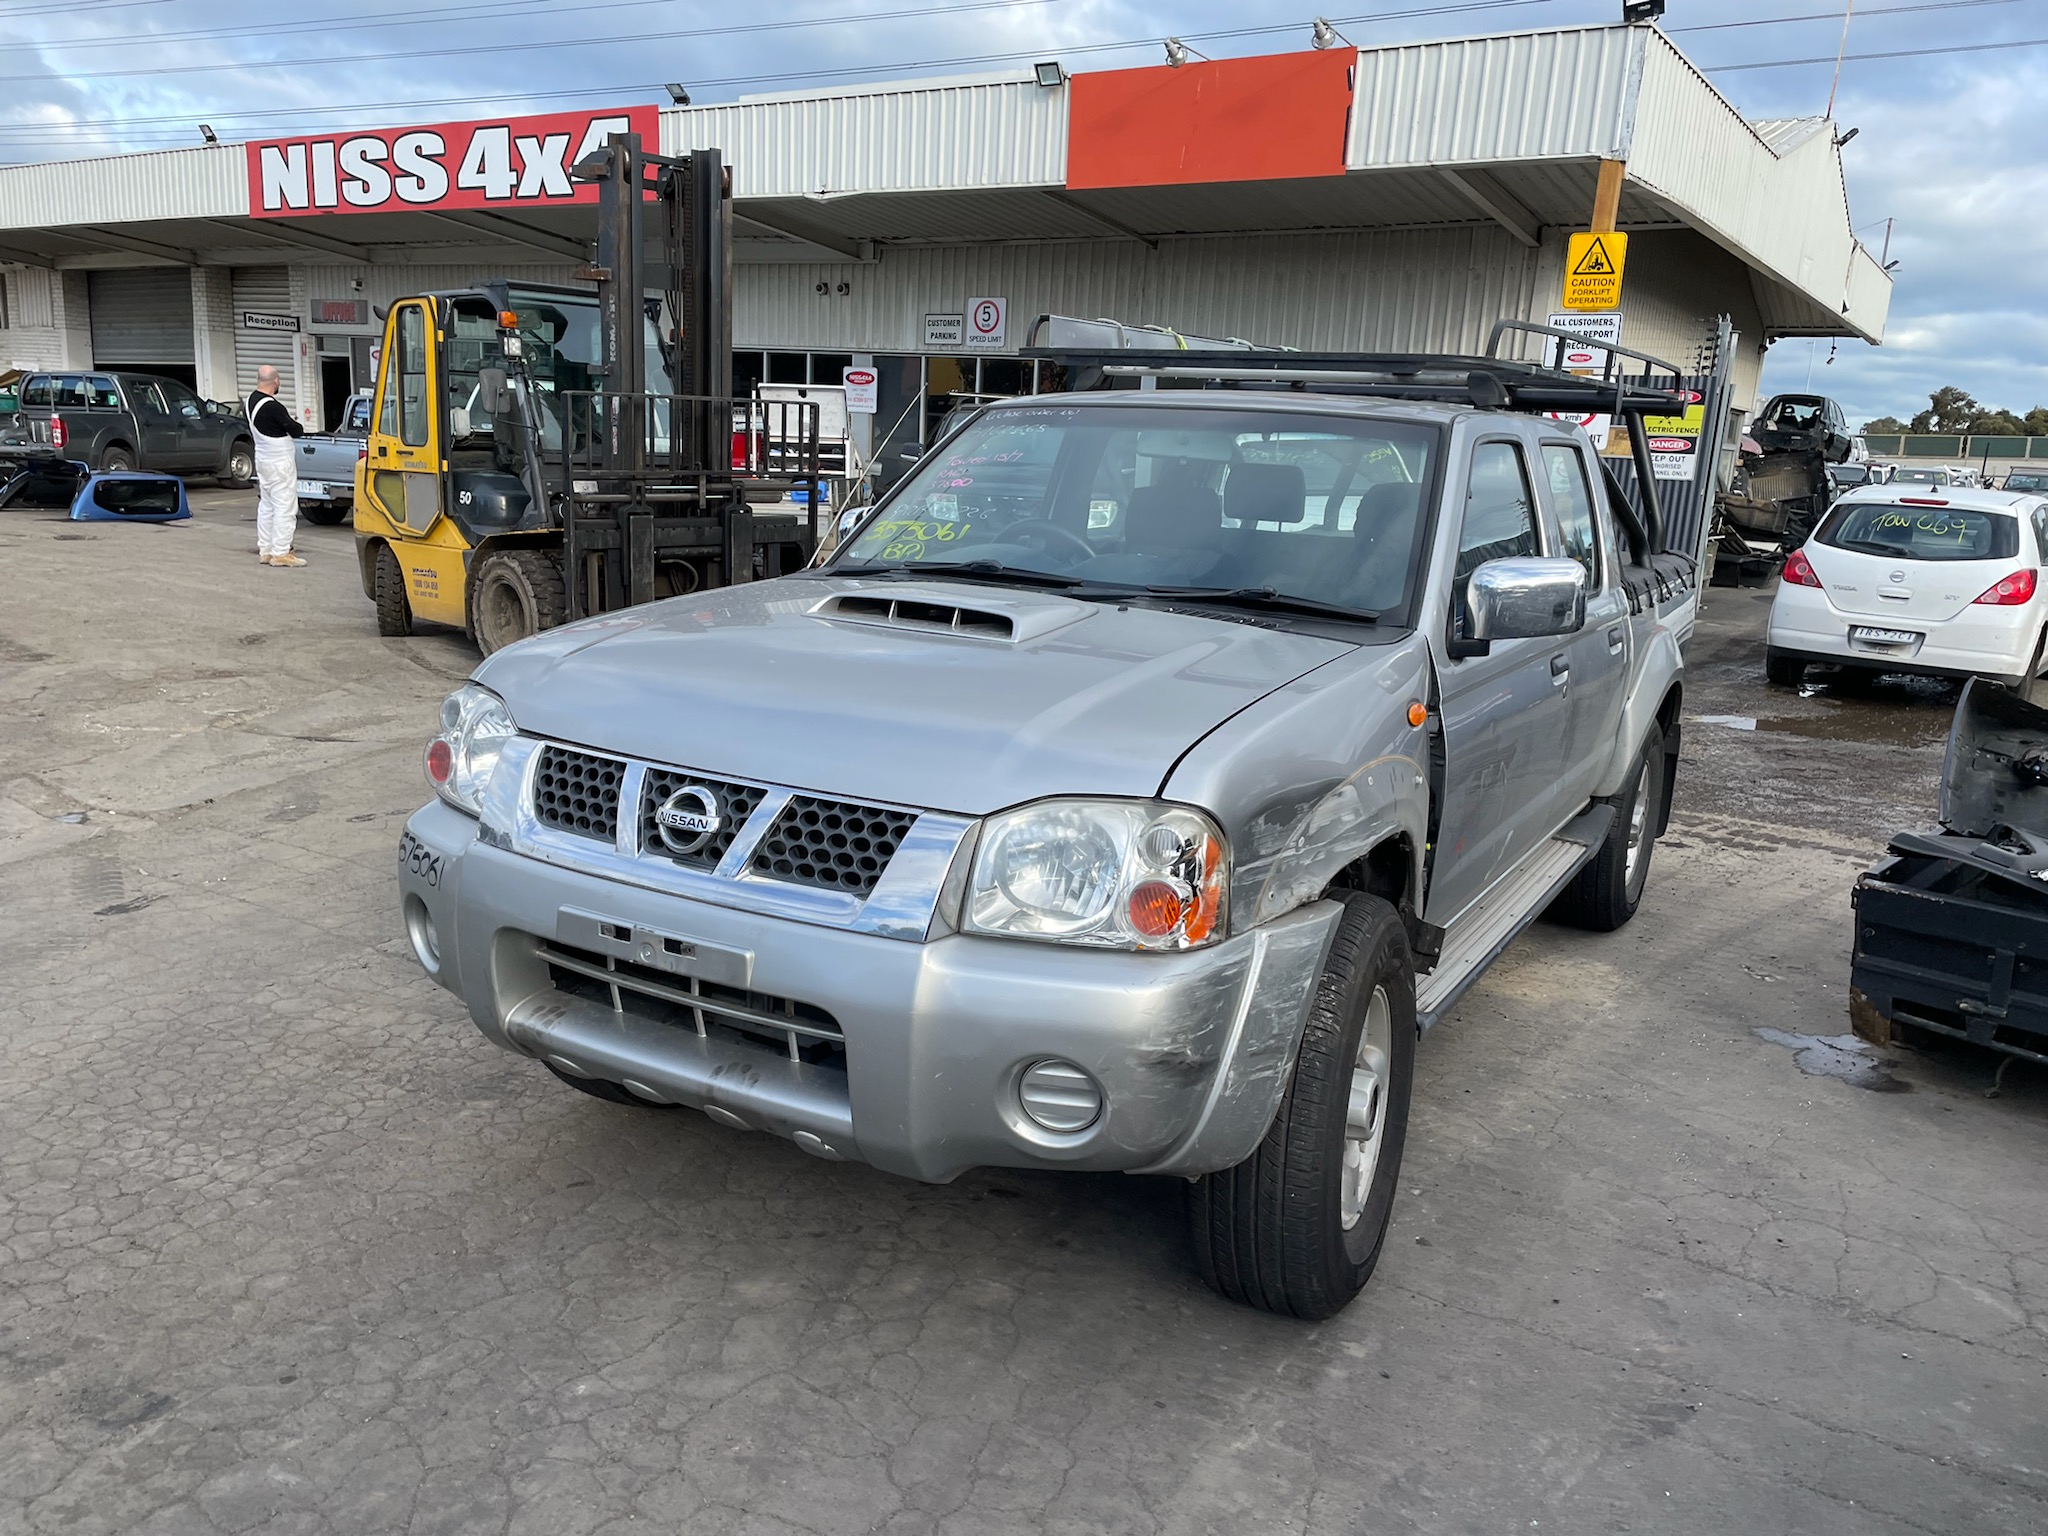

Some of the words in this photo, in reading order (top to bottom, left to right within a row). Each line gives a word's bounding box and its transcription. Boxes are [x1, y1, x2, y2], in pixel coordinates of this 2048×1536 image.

[259, 131, 449, 211] NISS
[1571, 278, 1616, 287] CAUTION
[1572, 288, 1611, 296] FORKLIFT
[1568, 296, 1613, 304] OPERATING
[982, 305, 991, 322] 5
[247, 315, 296, 328] Reception
[927, 319, 961, 327] CUSTOMER
[1553, 319, 1567, 327] ALL
[1568, 318, 1616, 328] CUSTOMERS,
[1583, 330, 1614, 338] REPORT
[987, 335, 1002, 343] LIMIT
[1565, 412, 1582, 420] kmh
[1675, 427, 1700, 435] FENCE
[1649, 440, 1685, 449] DANGER
[1650, 454, 1666, 462] EEP
[459, 491, 472, 505] 50
[1872, 511, 1912, 531] TOW
[660, 811, 709, 829] NISSAN
